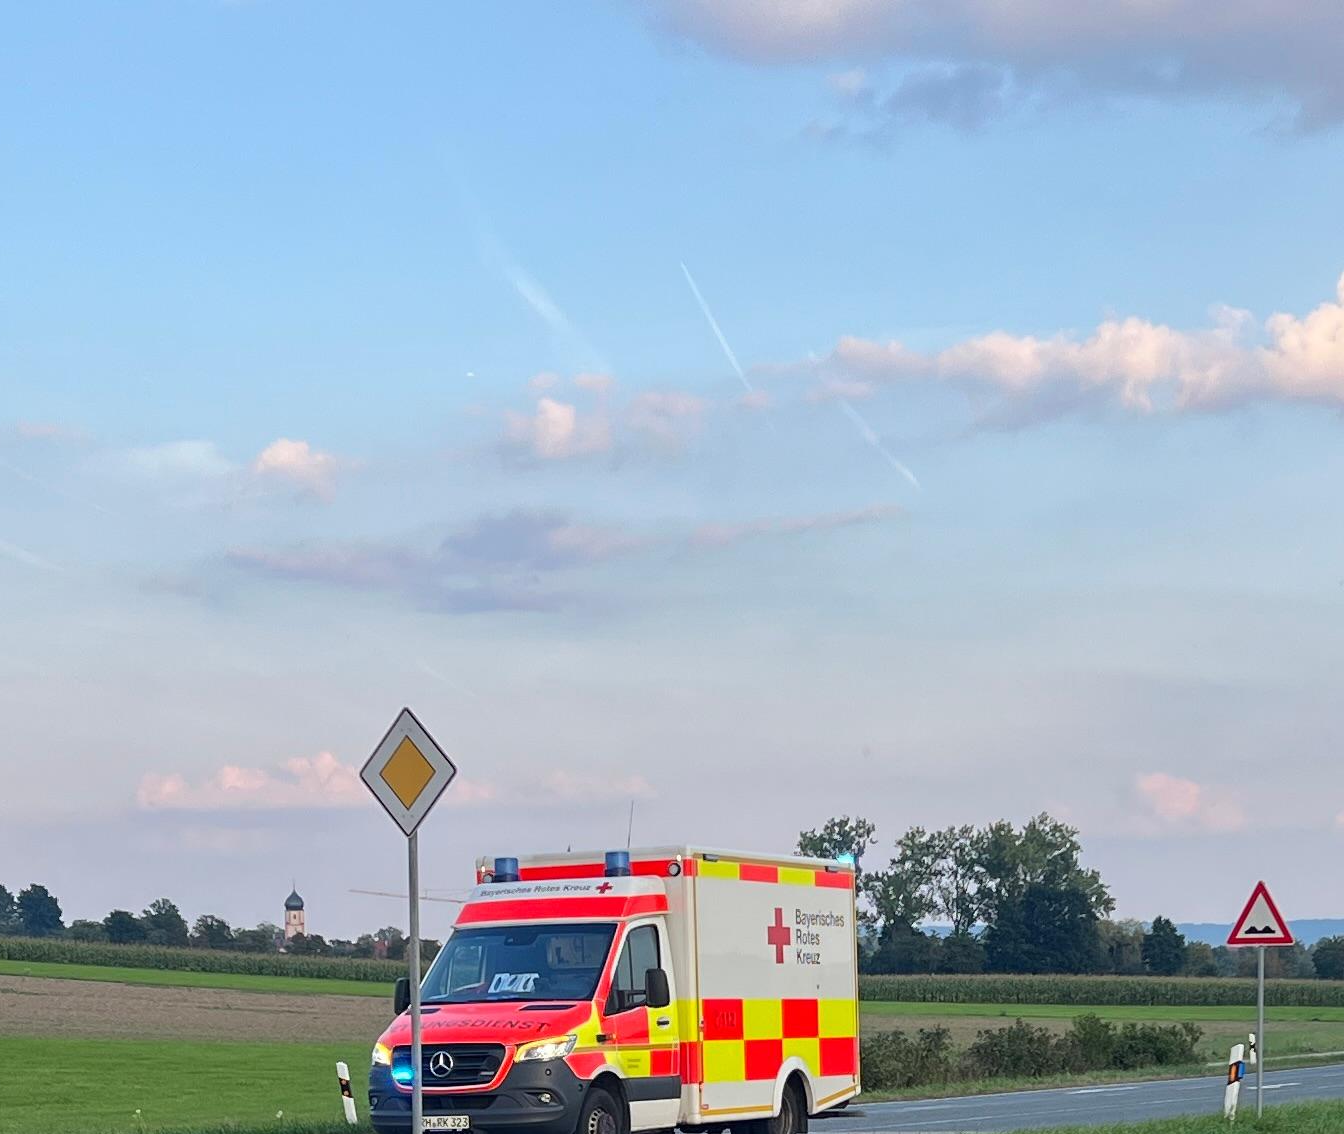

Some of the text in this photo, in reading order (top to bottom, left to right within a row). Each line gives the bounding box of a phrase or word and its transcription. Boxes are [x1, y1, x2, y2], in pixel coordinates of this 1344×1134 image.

[480, 884, 592, 897] Bayerisches Rotes Kreuz
[795, 908, 844, 928] Bayerisches
[795, 929, 820, 945] Rotes
[796, 949, 821, 965] Kreuz
[437, 1118, 449, 1128] RK
[451, 1117, 468, 1128] 323
